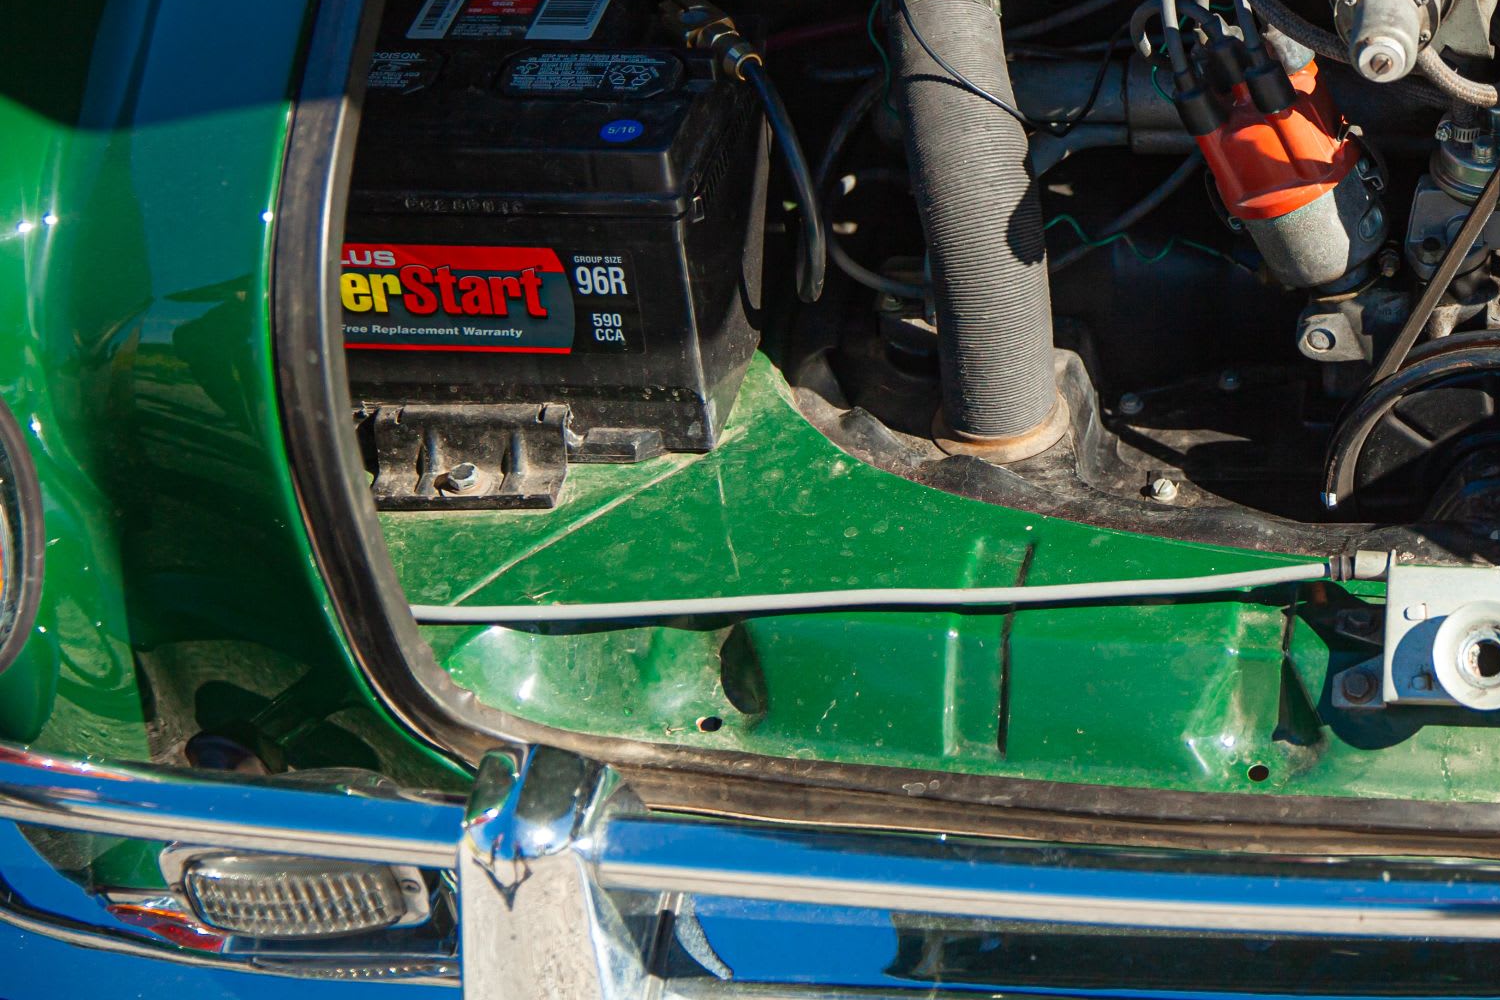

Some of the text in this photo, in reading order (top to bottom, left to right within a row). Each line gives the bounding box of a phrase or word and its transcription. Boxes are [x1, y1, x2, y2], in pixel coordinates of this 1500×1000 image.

[607, 126, 636, 135] 5/16
[574, 255, 622, 264] GROUP SIZE
[576, 266, 628, 295] 96R
[592, 313, 622, 327] 590
[372, 325, 459, 337] Replacement
[463, 327, 523, 338] Warranty
[595, 328, 626, 341] CCA
